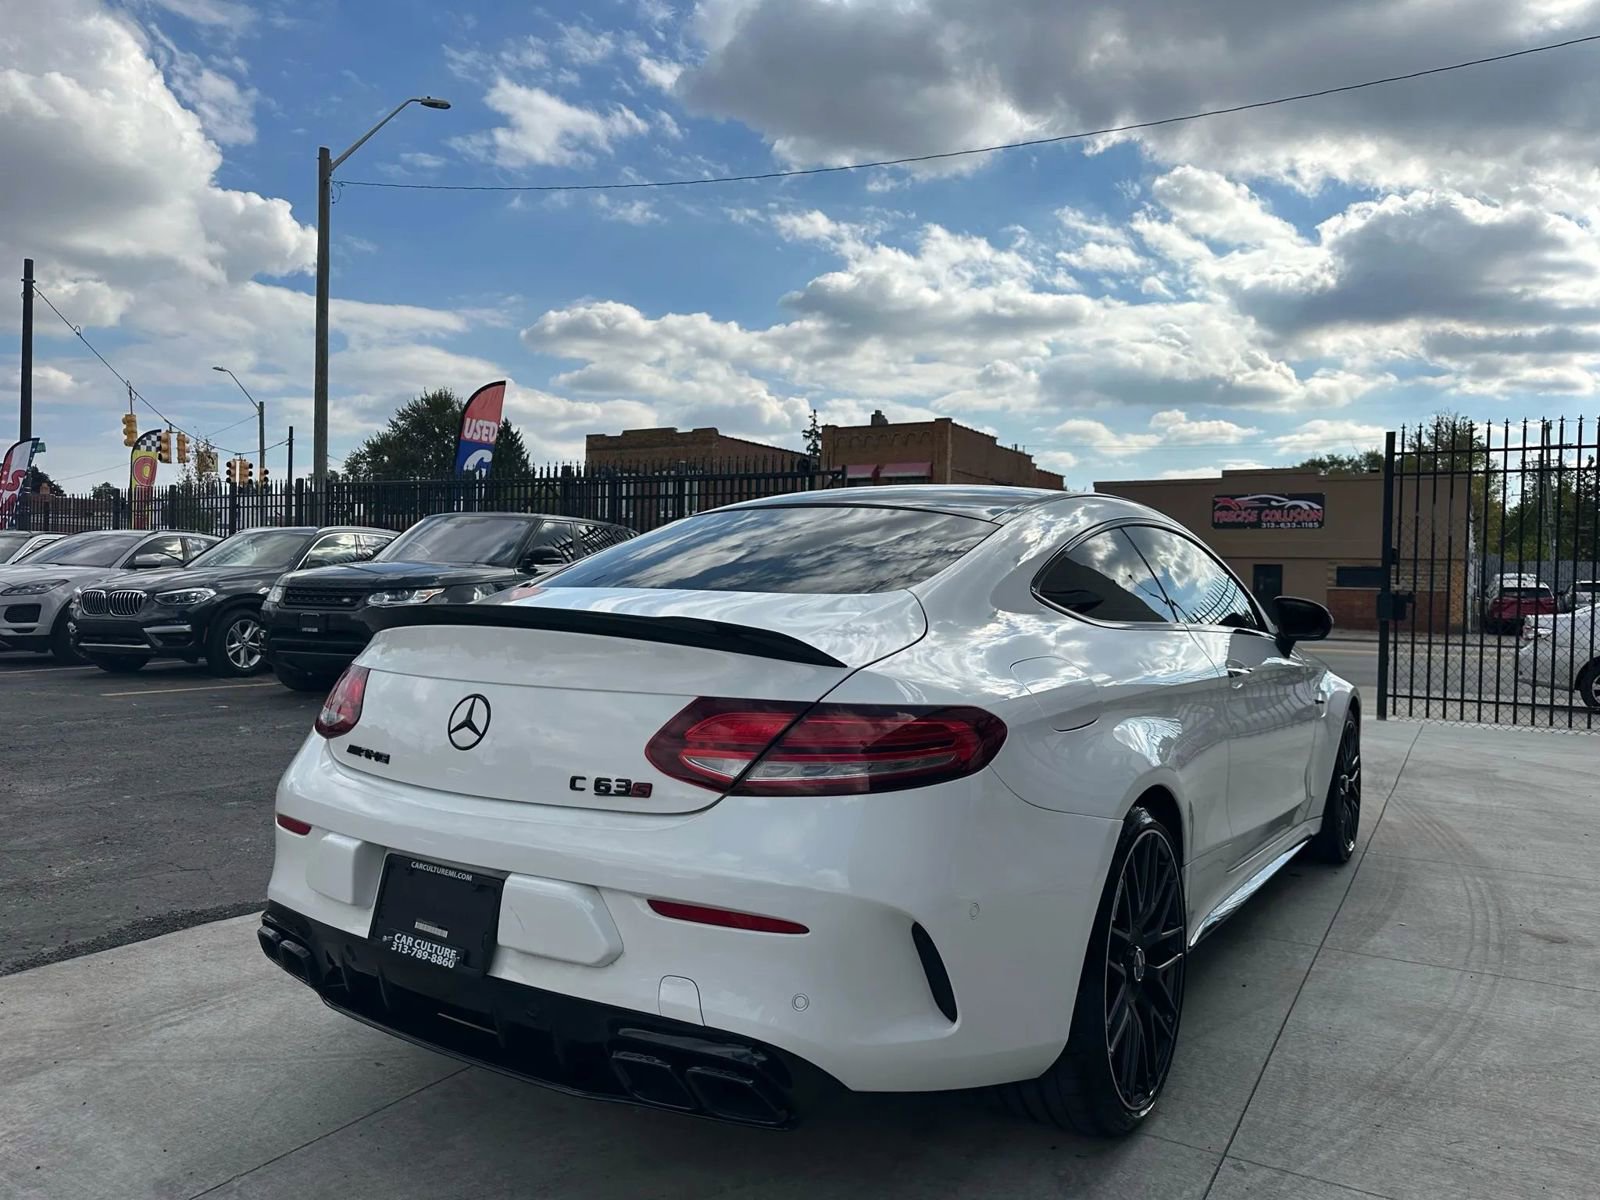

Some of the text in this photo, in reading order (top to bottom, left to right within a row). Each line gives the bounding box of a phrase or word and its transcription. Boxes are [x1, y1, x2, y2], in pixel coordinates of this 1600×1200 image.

[464, 417, 498, 442] USED
[1261, 509, 1323, 523] COLLISION
[569, 775, 587, 791] C
[411, 861, 473, 881] CARCULTUREMI.COM
[391, 941, 455, 969] 313-789-8860
[394, 933, 457, 959] CAR CULTURE
